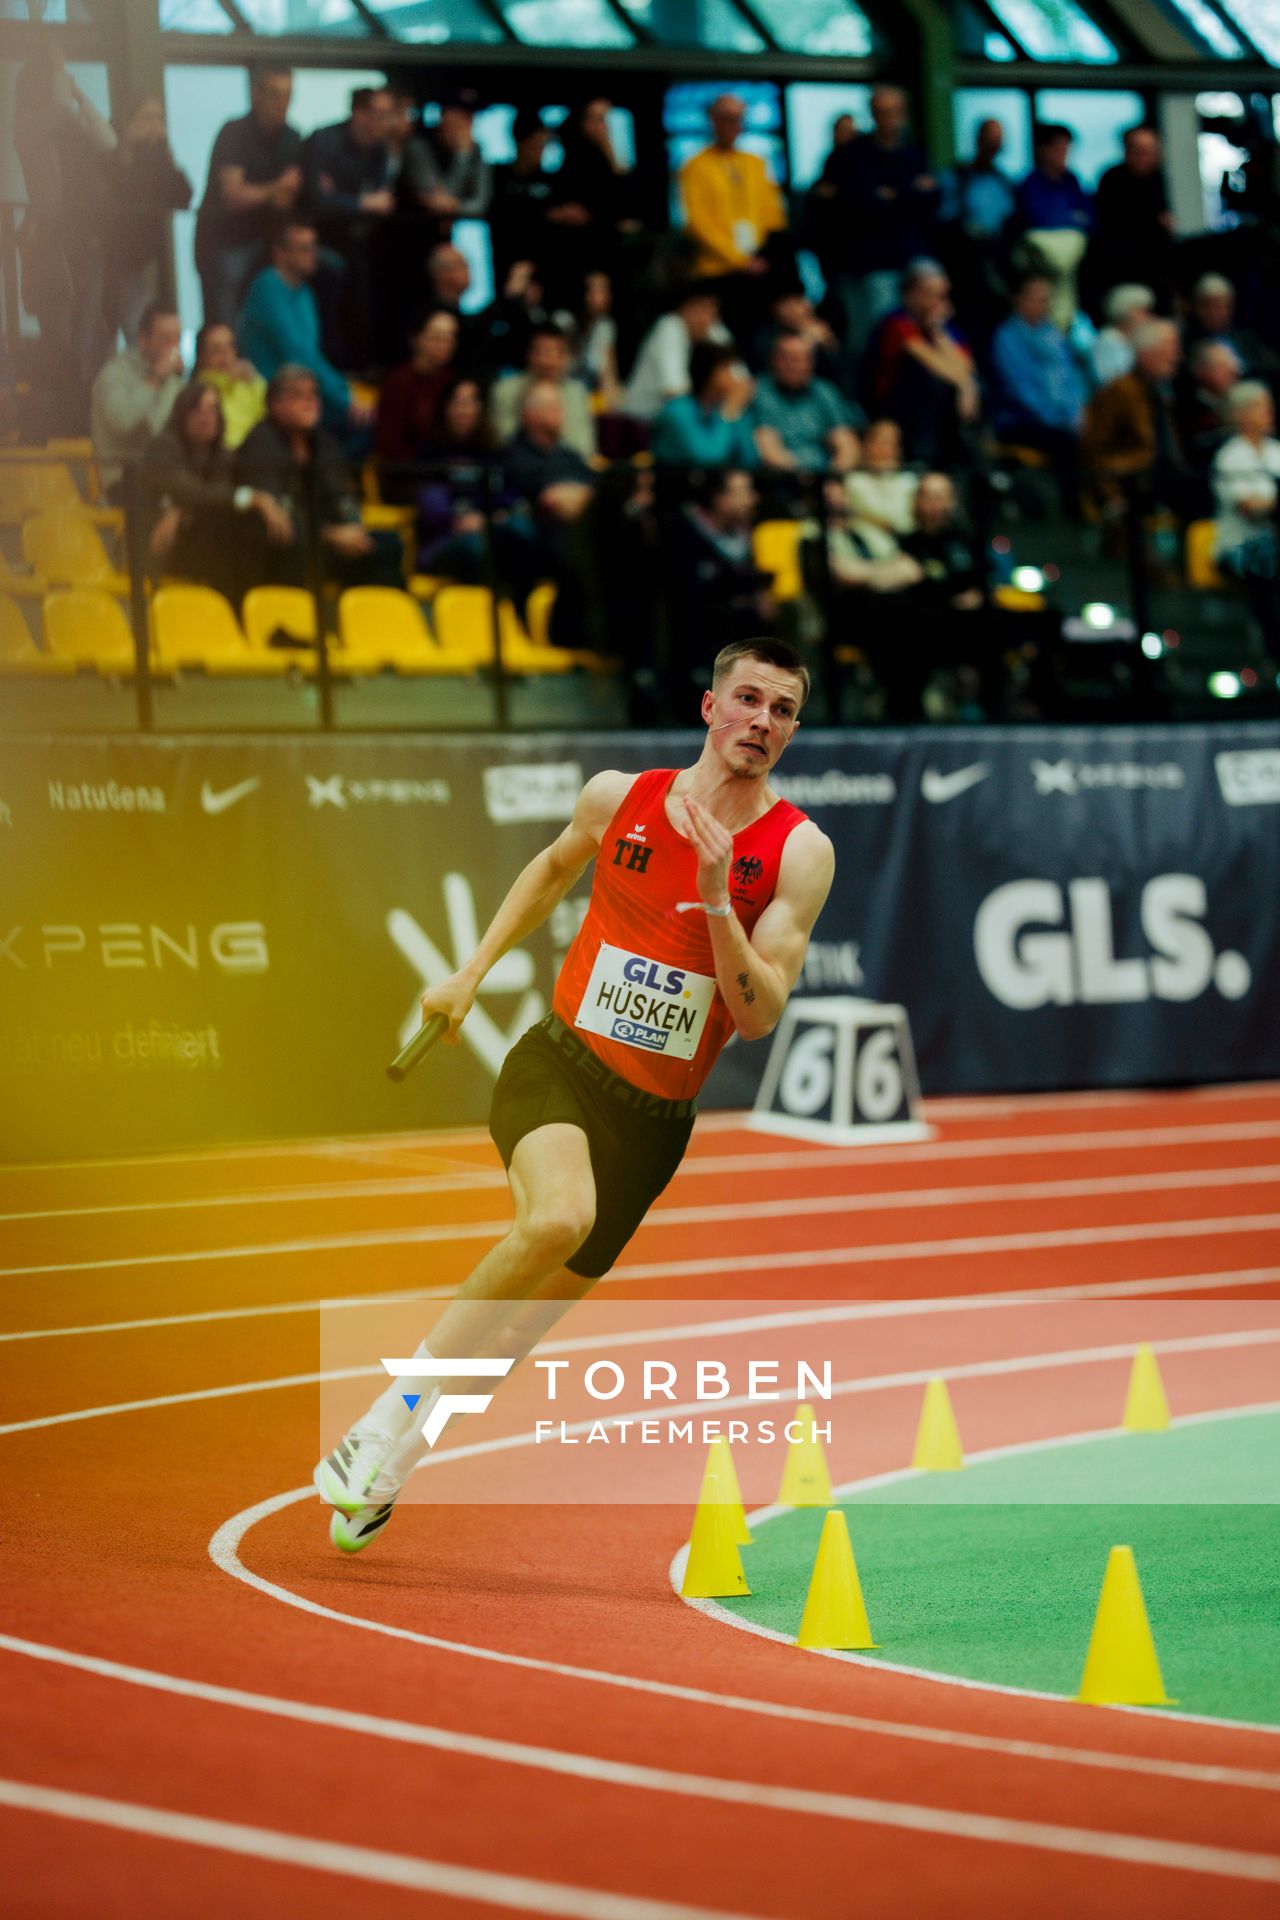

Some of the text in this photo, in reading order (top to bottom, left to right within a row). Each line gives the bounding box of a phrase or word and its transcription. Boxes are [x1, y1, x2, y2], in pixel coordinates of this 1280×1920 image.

[48, 779, 166, 812] NatuGena
[612, 838, 653, 874] TH
[973, 872, 1251, 1011] GLS.
[596, 980, 697, 1034] HÜSKEN
[634, 1026, 667, 1044] PLAN
[779, 1024, 836, 1117] 6
[855, 1025, 903, 1122] 6
